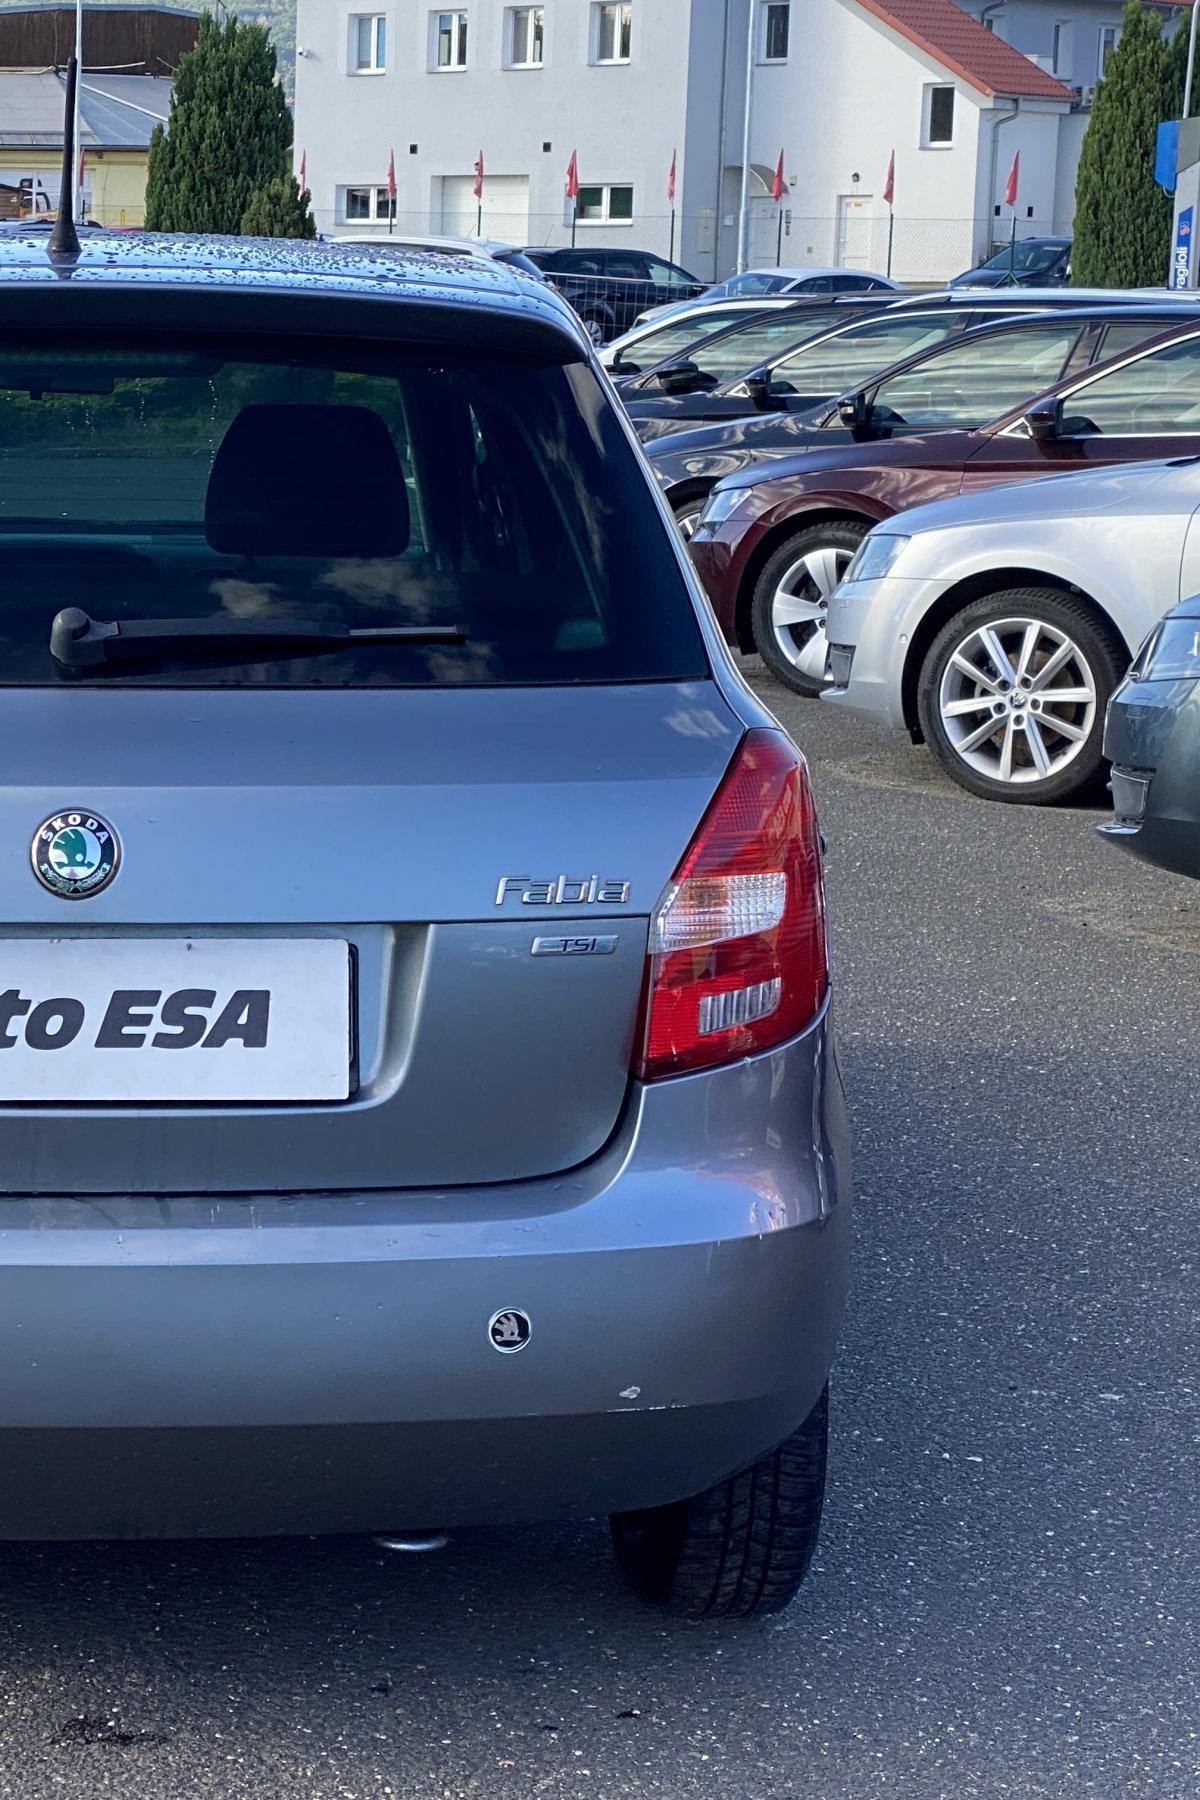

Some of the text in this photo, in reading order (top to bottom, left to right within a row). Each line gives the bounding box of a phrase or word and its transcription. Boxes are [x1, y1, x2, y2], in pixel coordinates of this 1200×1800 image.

[495, 874, 631, 905] Fabia
[559, 938, 598, 953] TSI
[93, 988, 271, 1049] ESA
